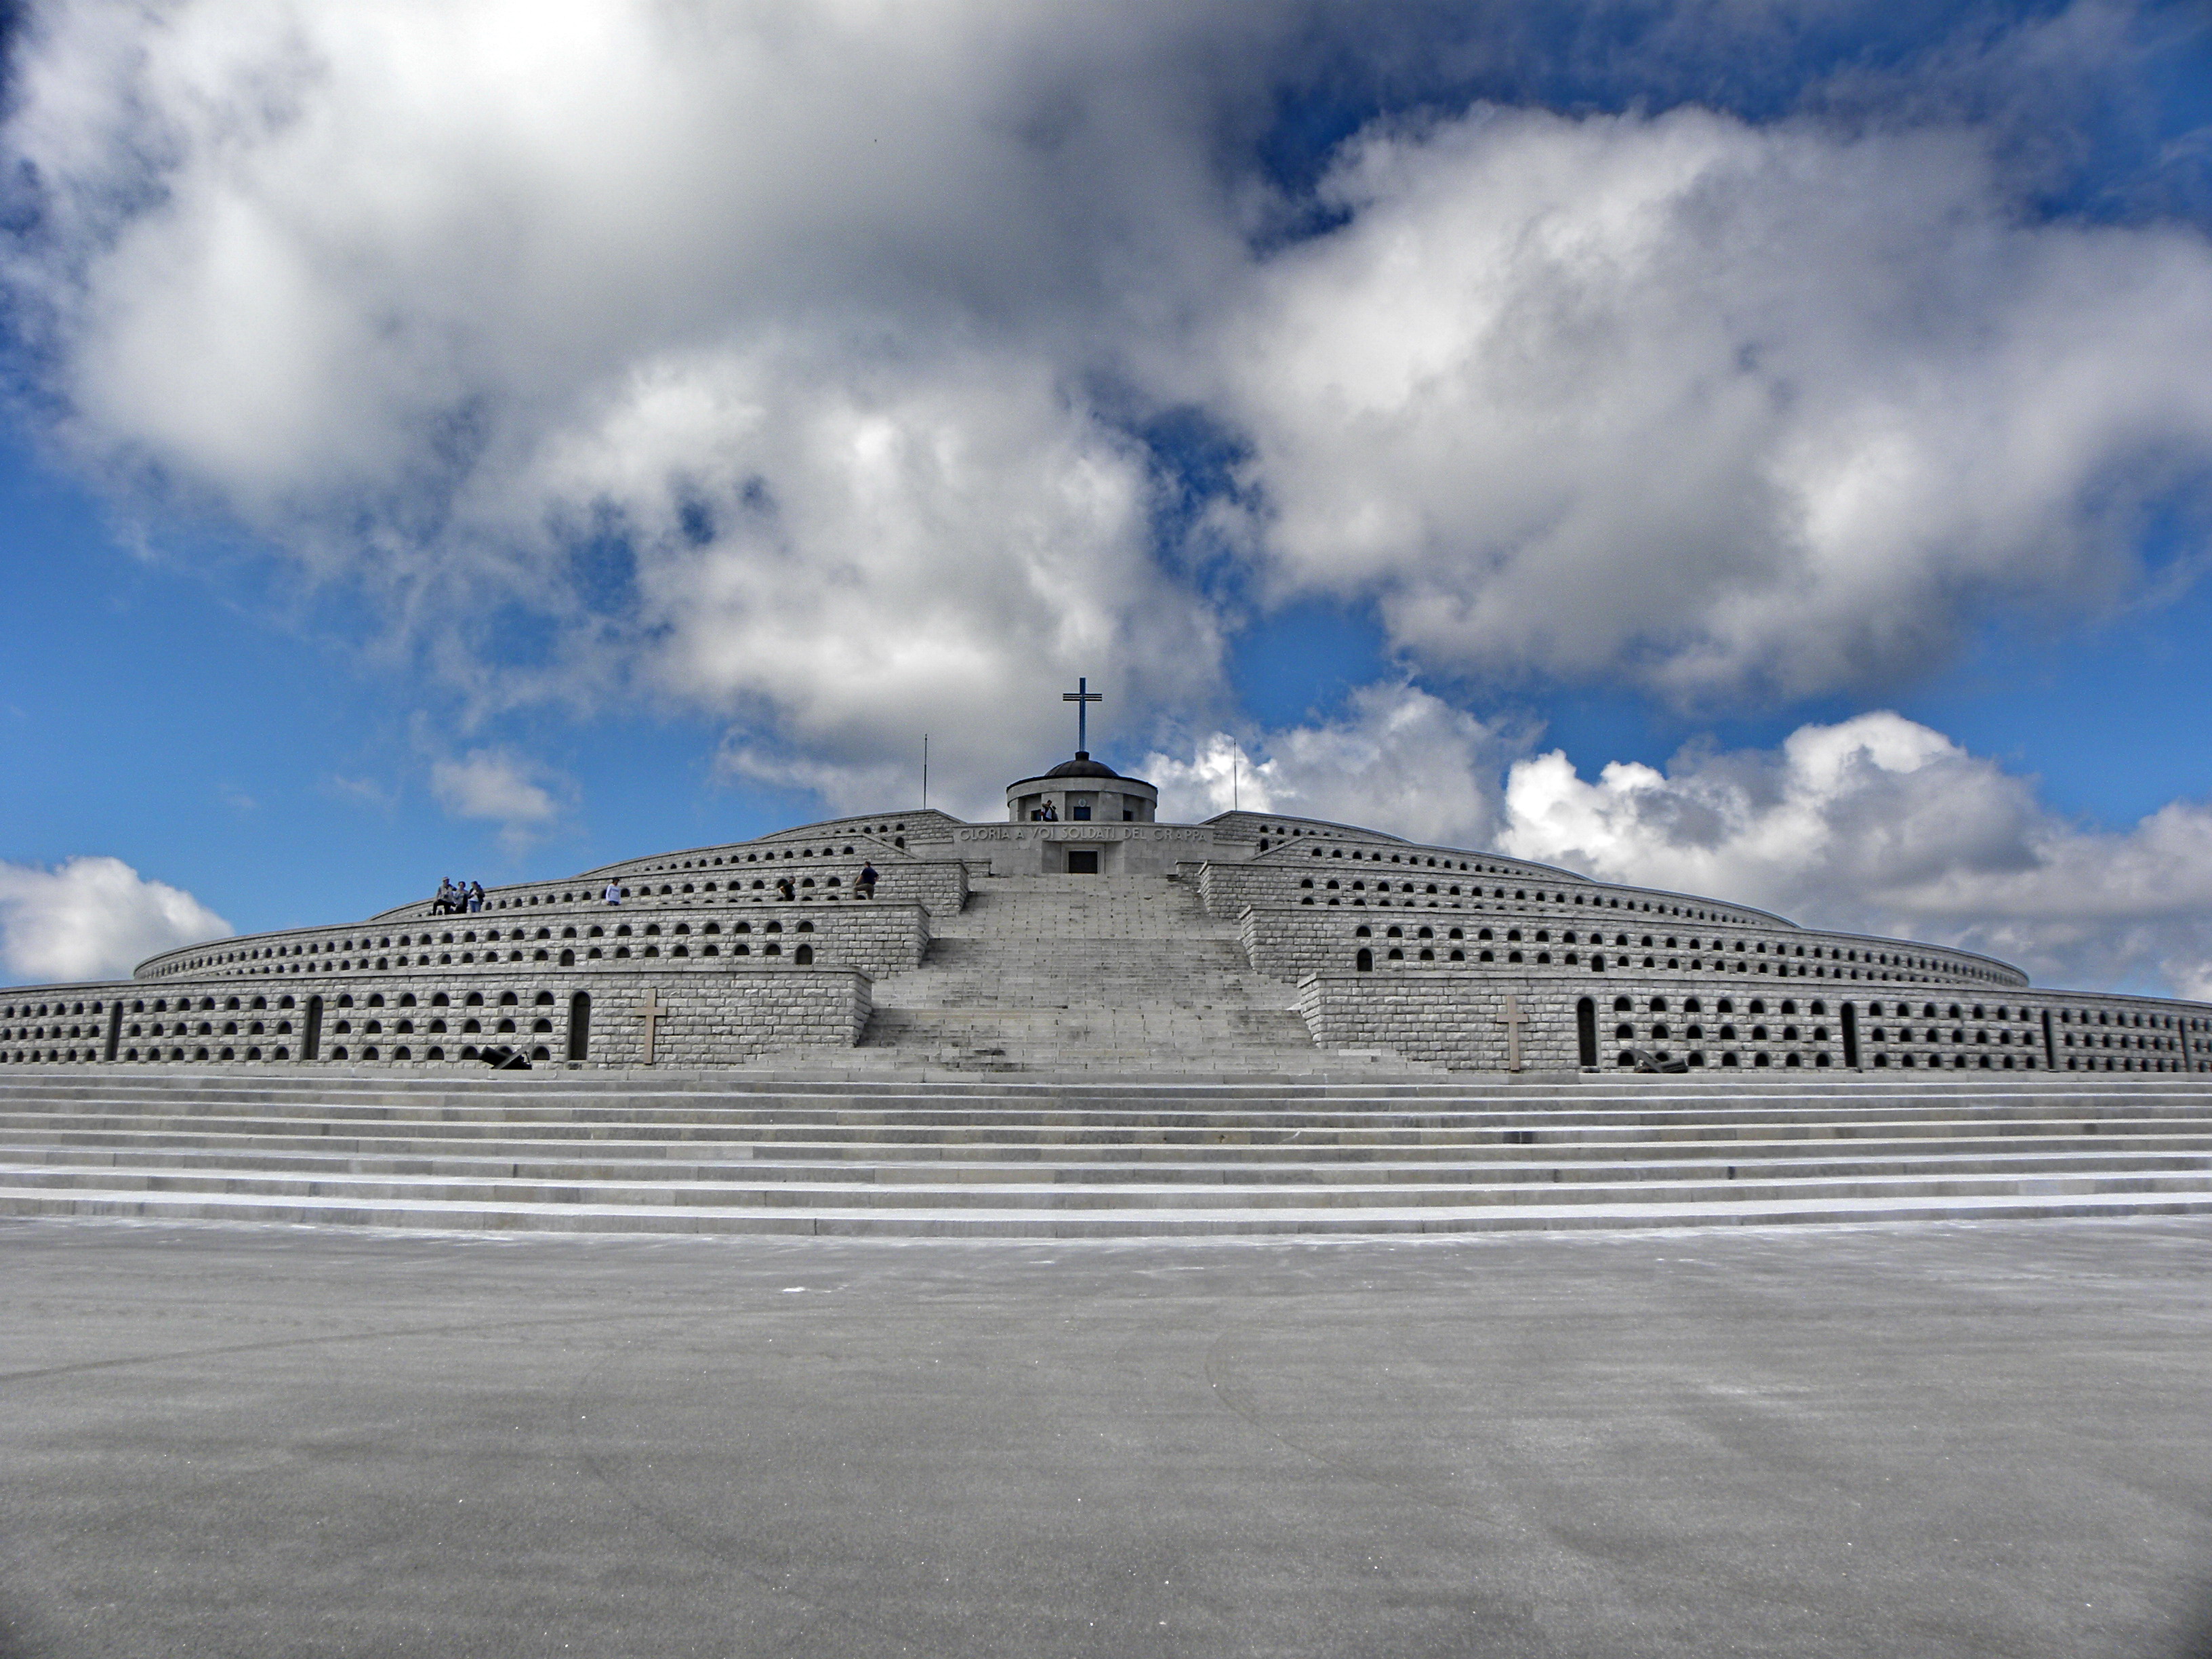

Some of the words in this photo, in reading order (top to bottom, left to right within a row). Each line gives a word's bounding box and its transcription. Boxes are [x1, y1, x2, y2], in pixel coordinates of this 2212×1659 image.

[1015, 828, 1025, 840] A
[1031, 826, 1054, 840] VOI
[1061, 827, 1115, 840] SOLDATI
[1124, 827, 1147, 840] DEL
